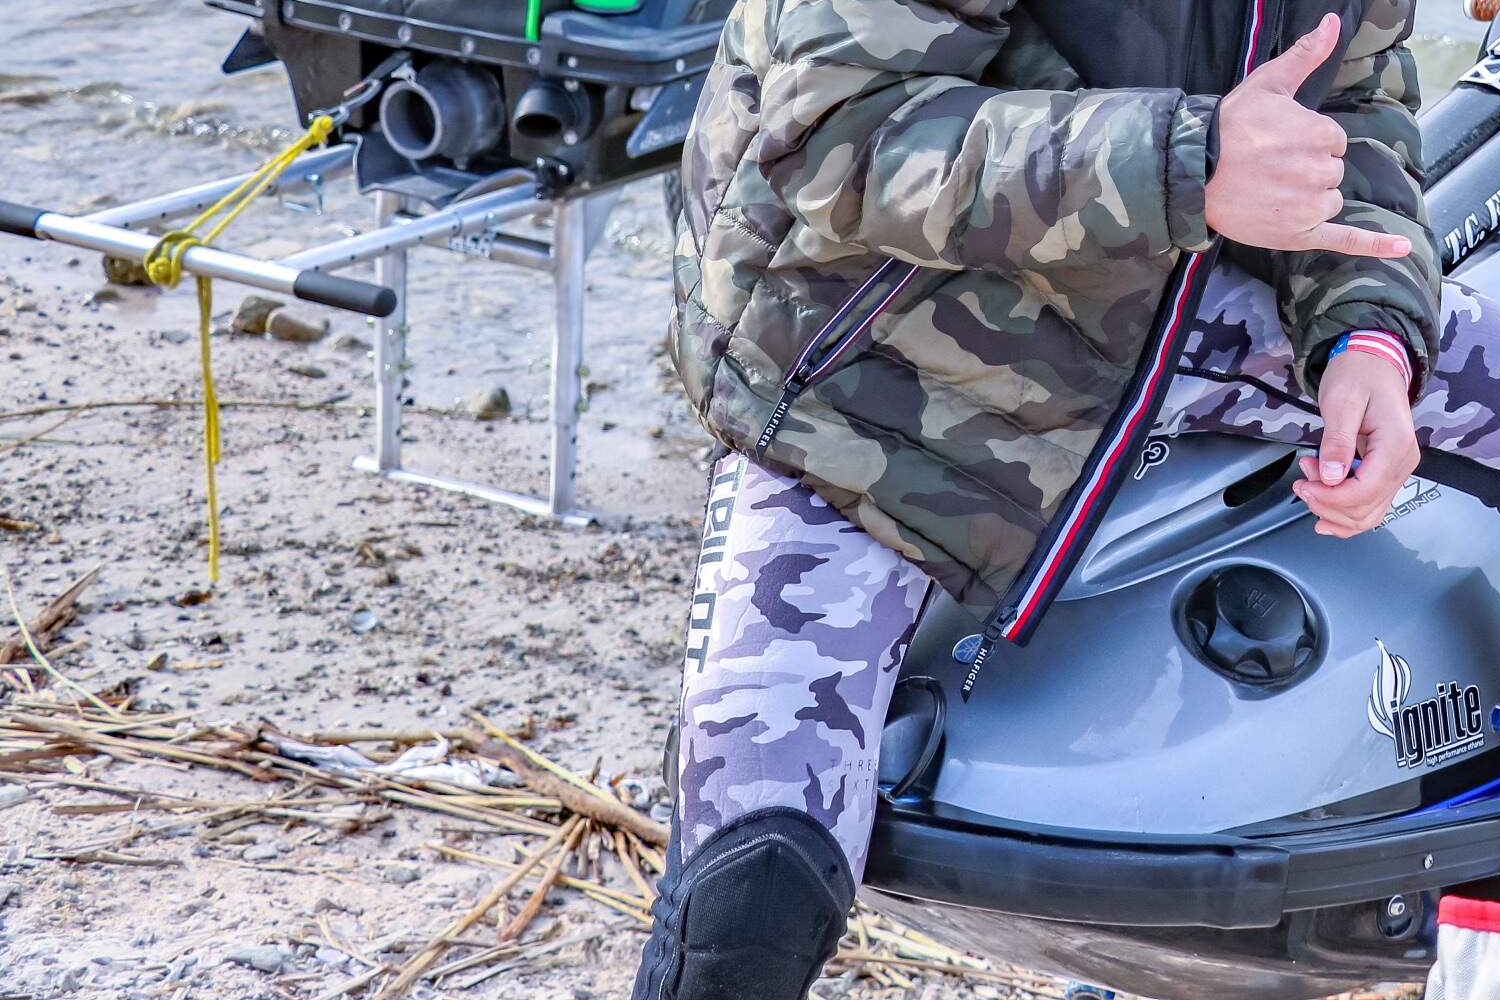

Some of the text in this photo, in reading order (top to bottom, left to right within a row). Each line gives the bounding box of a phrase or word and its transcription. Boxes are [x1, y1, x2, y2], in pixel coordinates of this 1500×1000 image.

[1443, 212, 1486, 265] T.C.
[758, 401, 788, 447] HILFIGER
[686, 455, 749, 674] TPILOT
[962, 647, 988, 692] HILFIGER
[1391, 681, 1482, 769] ignite
[1426, 738, 1485, 767] high performance ethanol
